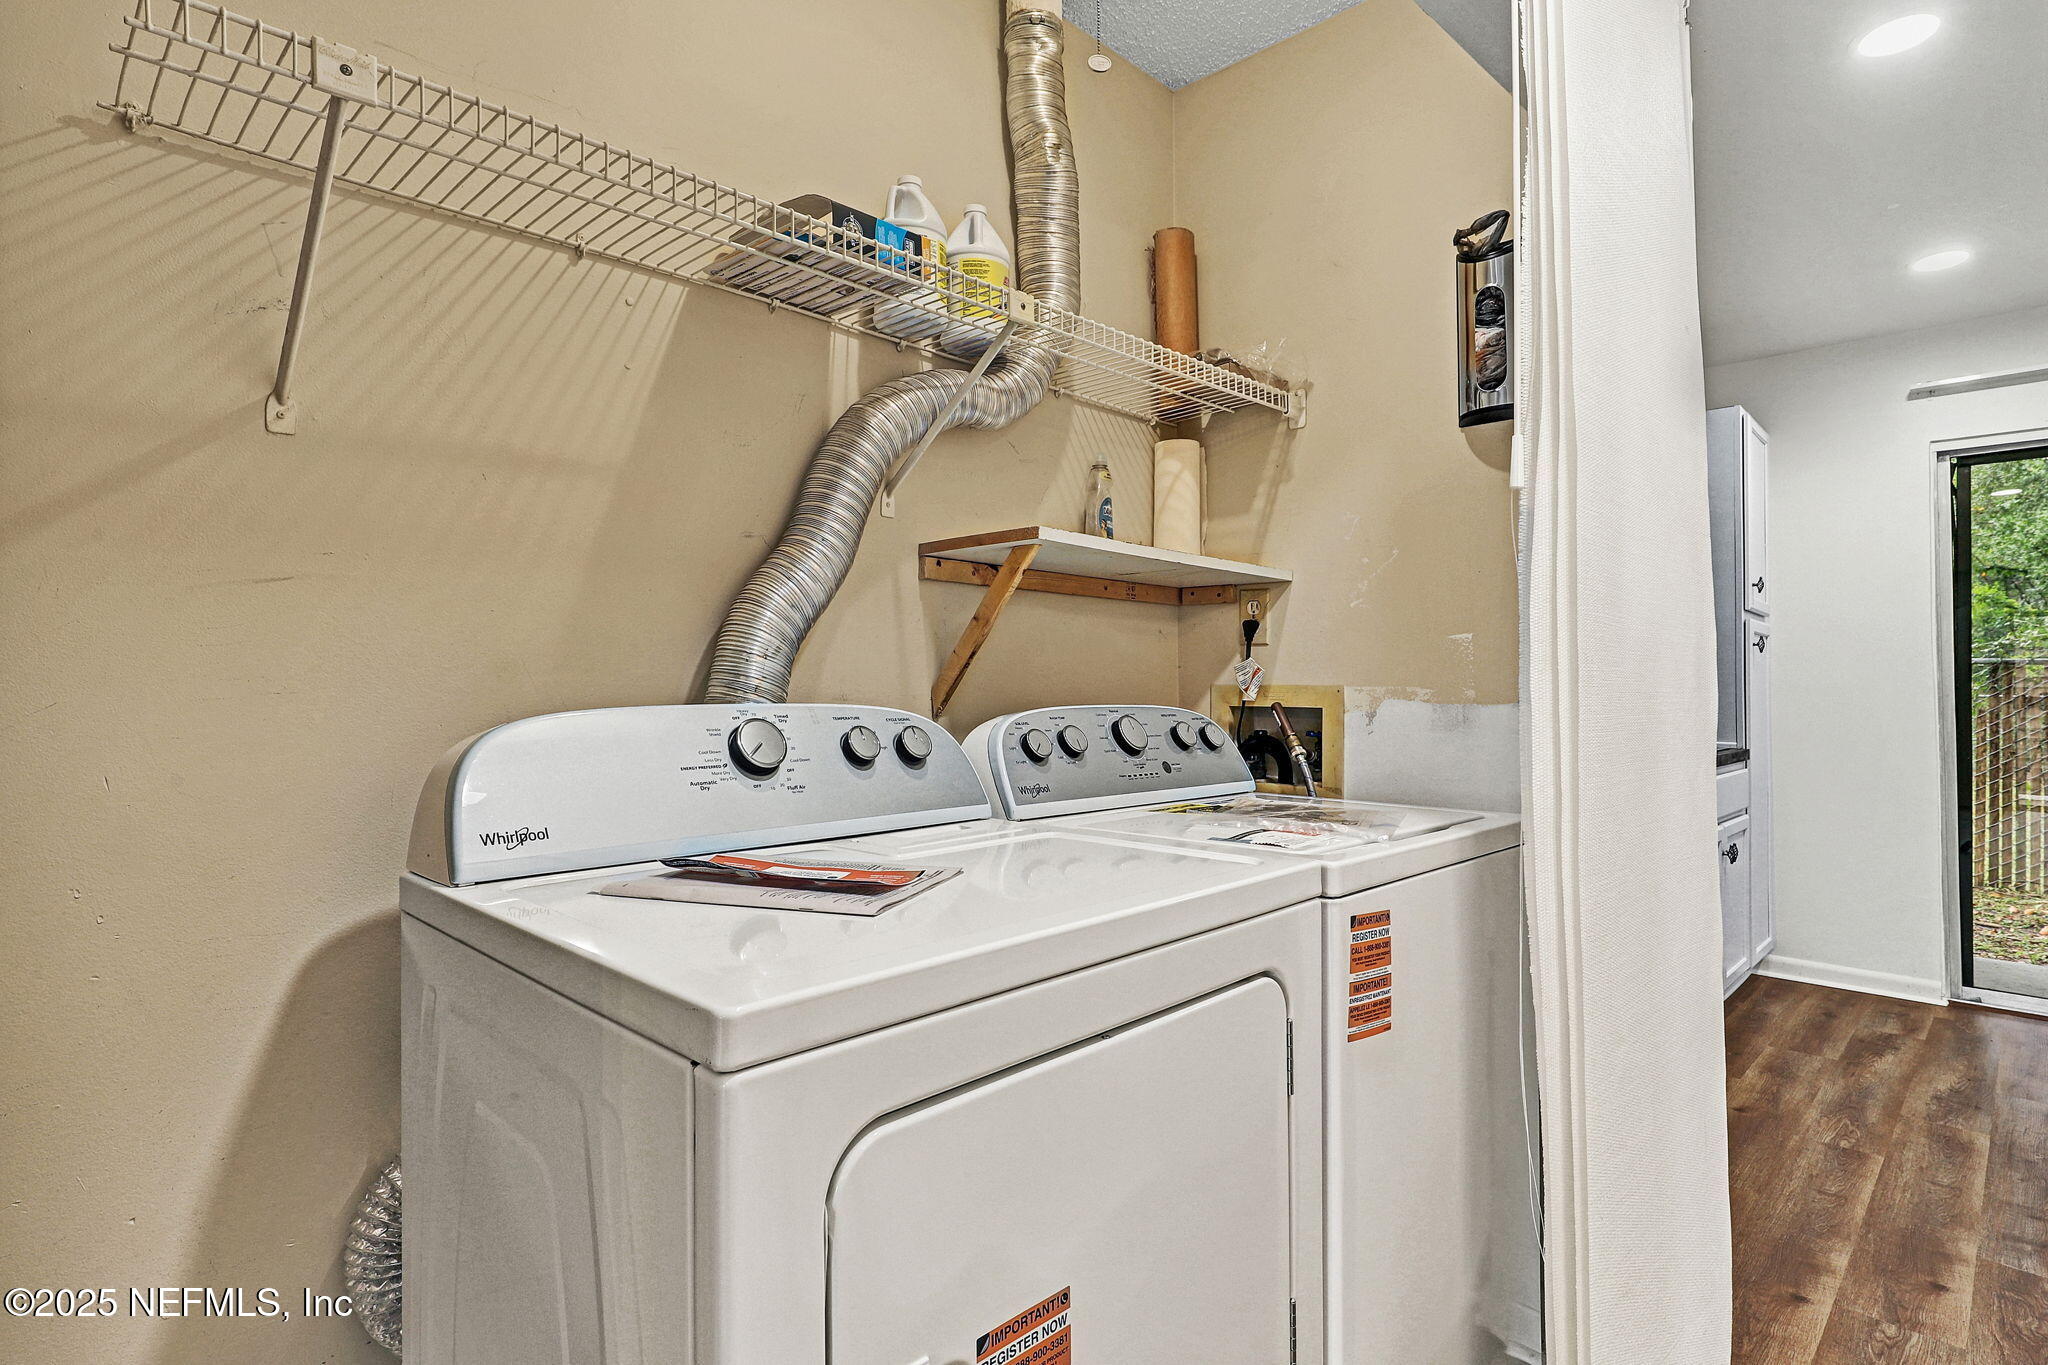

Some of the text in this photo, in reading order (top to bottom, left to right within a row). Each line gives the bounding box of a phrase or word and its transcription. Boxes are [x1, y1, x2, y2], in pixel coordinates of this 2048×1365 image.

[1017, 783, 1051, 798] Whirlpool
[479, 827, 549, 850] Whirlpool
[1351, 927, 1390, 943] REGISTER NOW
[1351, 946, 1363, 955] CALL
[991, 1296, 1060, 1347] IMPORTANT!
[1042, 1313, 1068, 1339] NOW
[1046, 1346, 1069, 1364] PRODUCT
